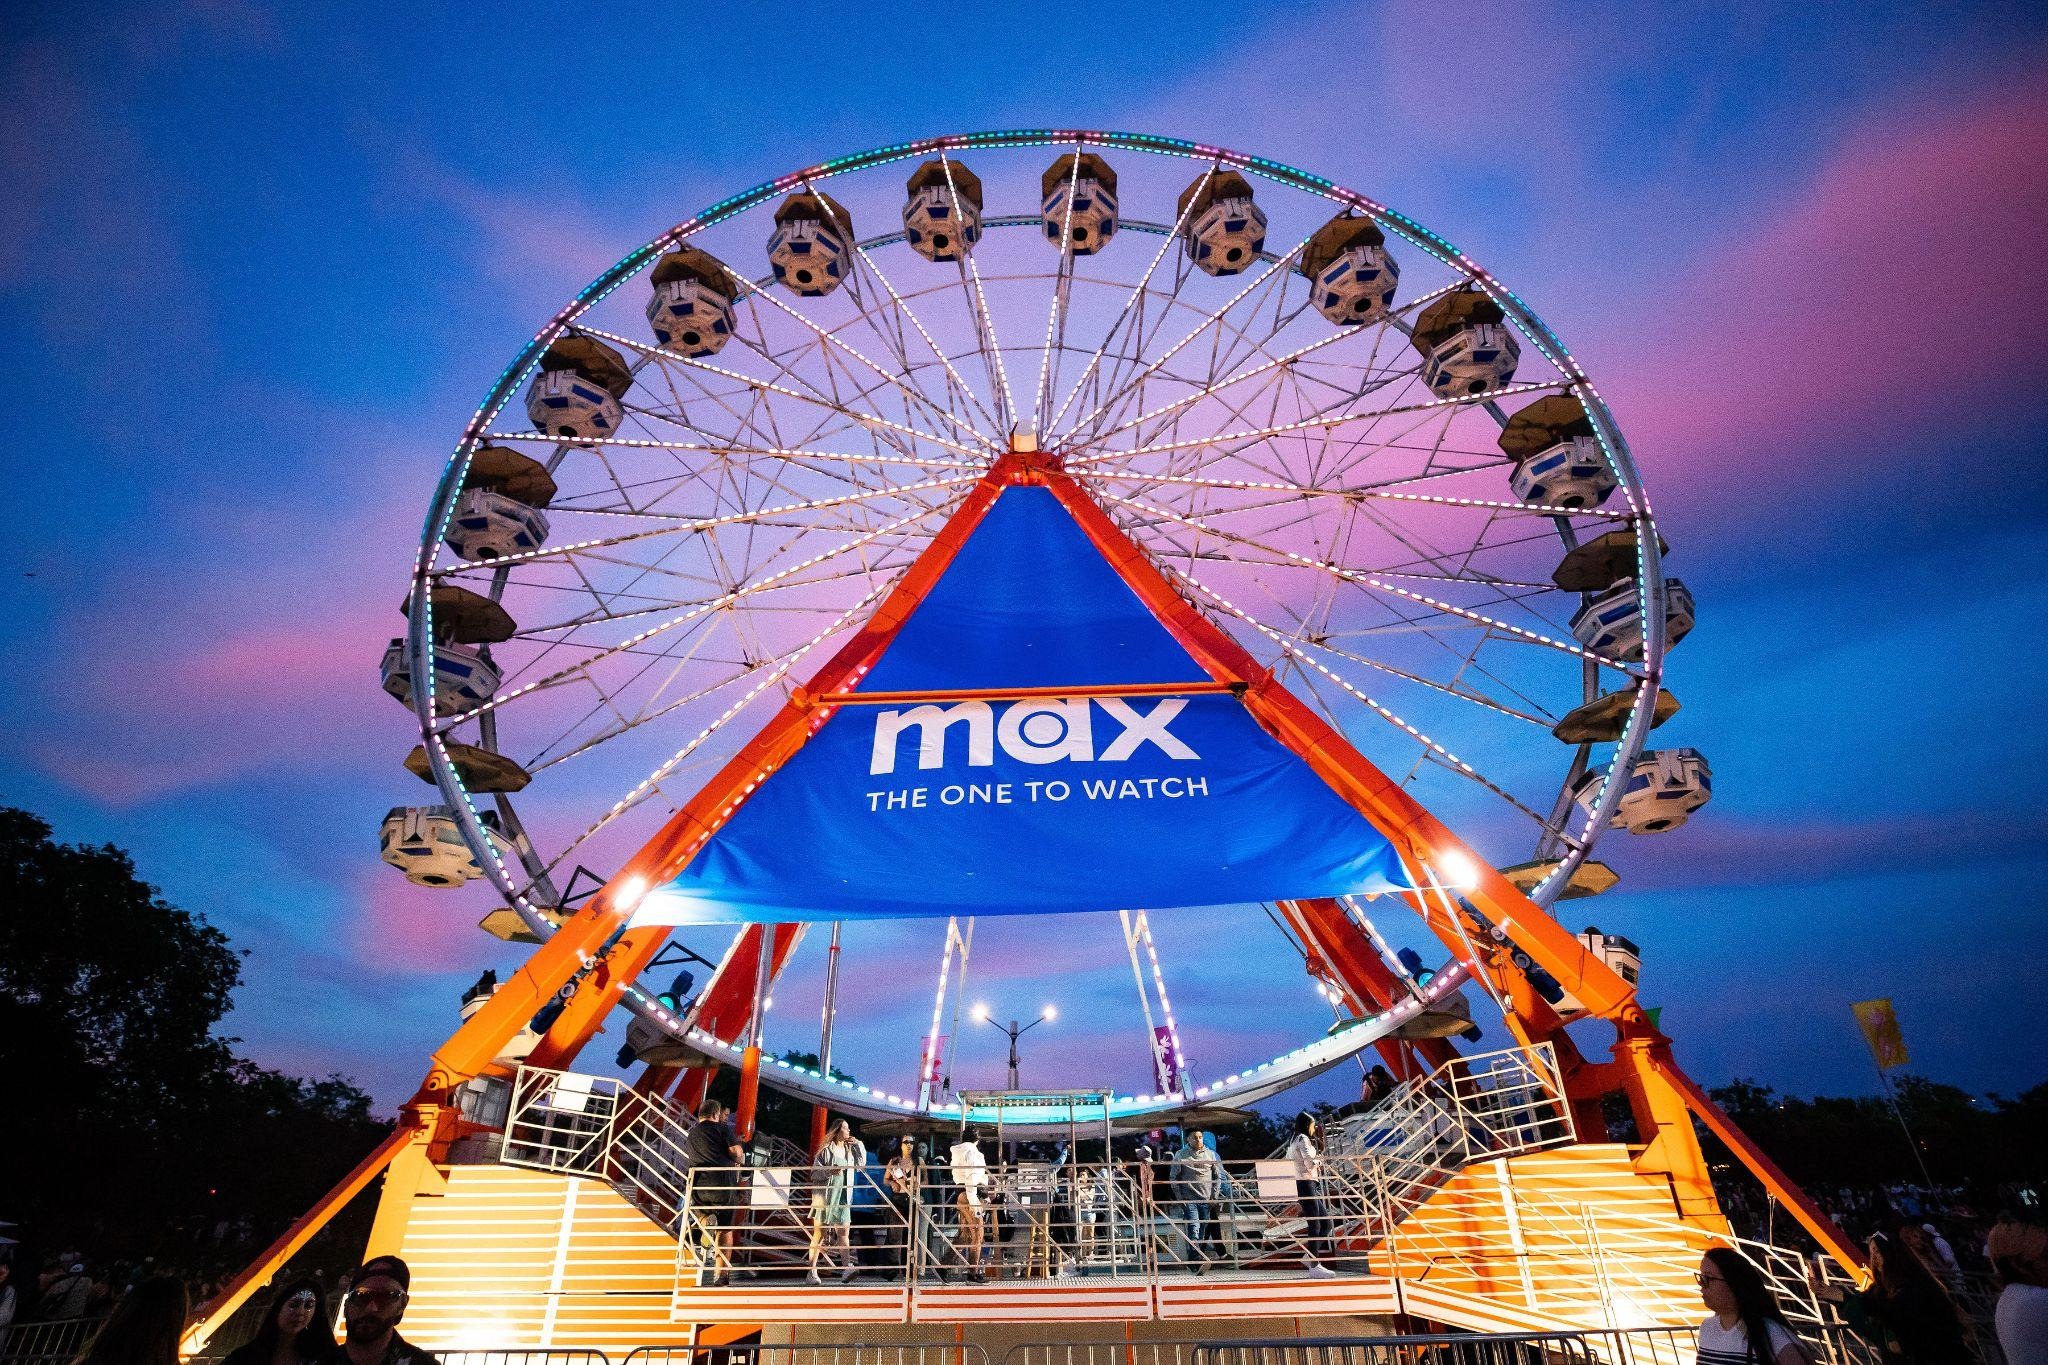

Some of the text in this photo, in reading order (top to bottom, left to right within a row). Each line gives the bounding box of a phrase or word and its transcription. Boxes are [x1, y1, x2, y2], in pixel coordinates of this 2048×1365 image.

[869, 697, 1202, 775] max
[866, 777, 1209, 812] THE ONE TO WATCH
[1609, 935, 1615, 944] 9
